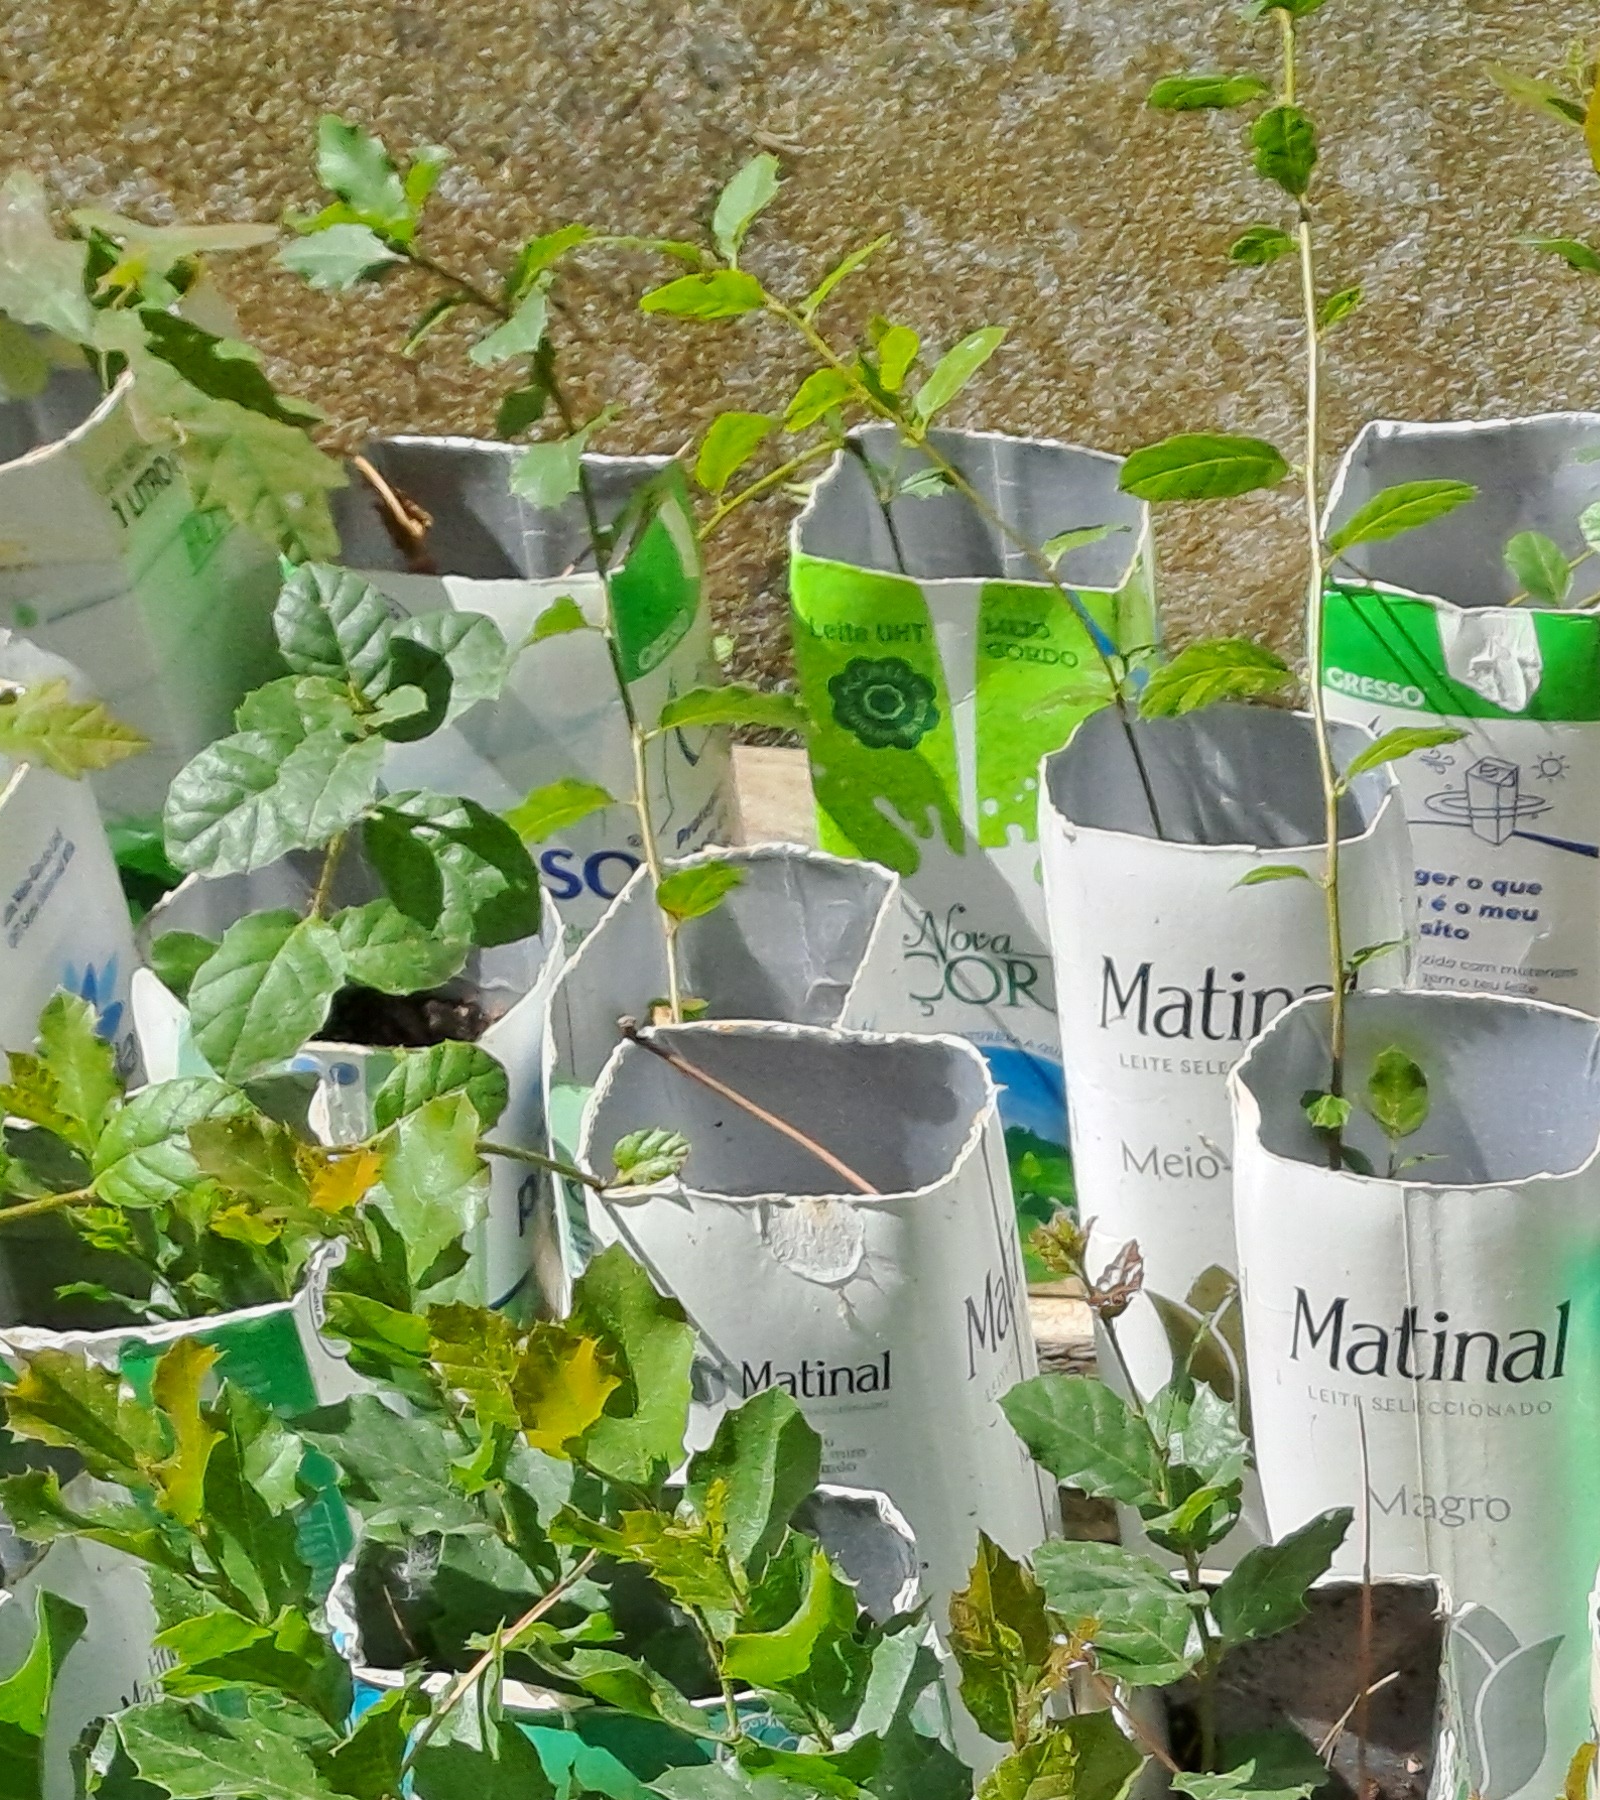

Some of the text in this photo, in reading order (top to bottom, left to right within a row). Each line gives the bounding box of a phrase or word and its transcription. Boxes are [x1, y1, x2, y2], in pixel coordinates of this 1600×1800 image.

[874, 622, 928, 645] UHT
[986, 642, 1079, 669] GORDO
[1325, 667, 1426, 708] GRESSO
[1491, 875, 1542, 900] que
[901, 902, 1014, 963] Nova
[1480, 903, 1539, 924] meu
[1101, 961, 1277, 1043] Matin
[1119, 1053, 1174, 1074] LEITE
[1289, 1286, 1572, 1384] Matinal
[742, 1351, 892, 1400] Matinal
[1307, 1384, 1553, 1419] LEITE SELECCIONADO
[1370, 1480, 1512, 1530] Magro
